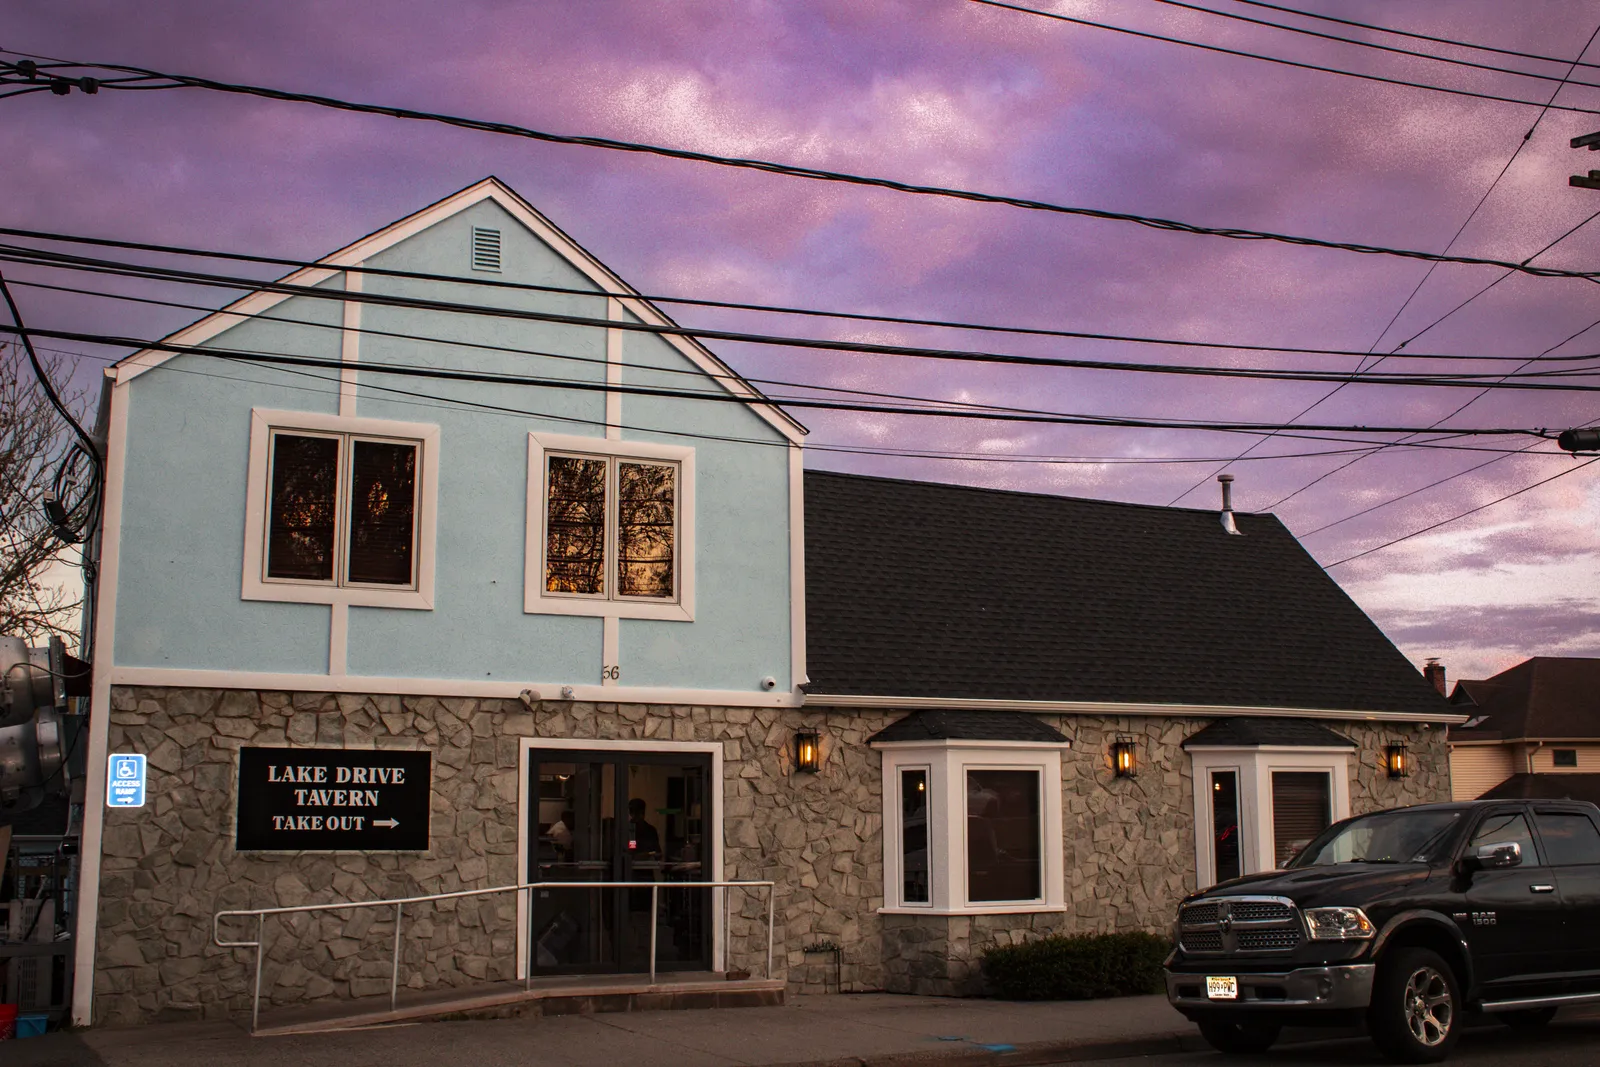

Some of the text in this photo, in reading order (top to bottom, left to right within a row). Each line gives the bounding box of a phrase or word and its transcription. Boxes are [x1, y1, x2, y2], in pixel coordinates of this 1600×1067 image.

[603, 665, 620, 680] 56
[268, 766, 405, 784] LAKE DRIVE
[294, 789, 379, 807] TAVERN
